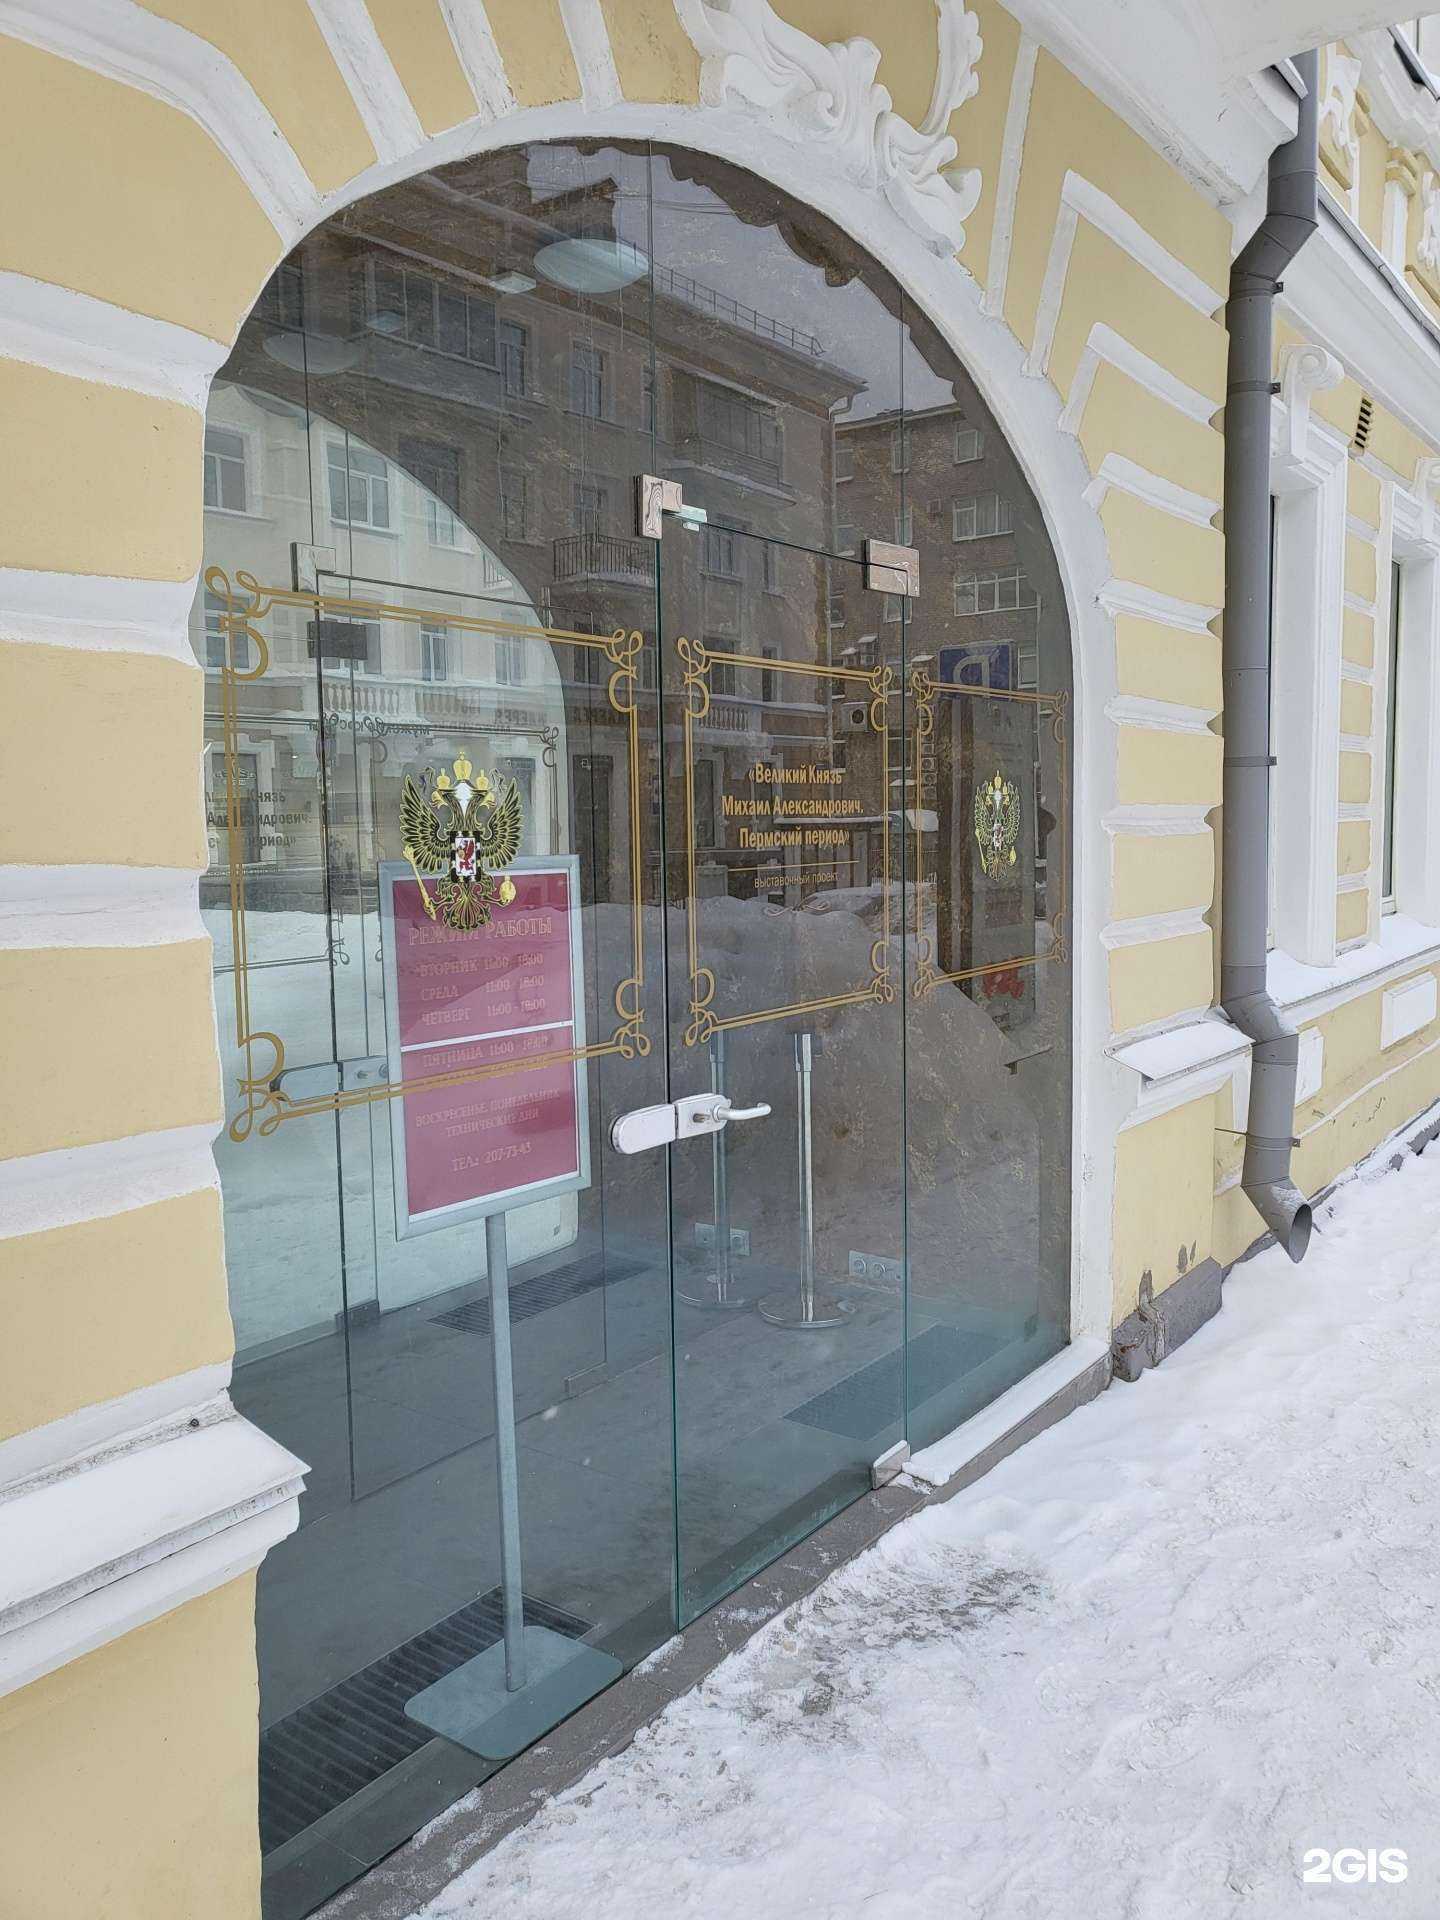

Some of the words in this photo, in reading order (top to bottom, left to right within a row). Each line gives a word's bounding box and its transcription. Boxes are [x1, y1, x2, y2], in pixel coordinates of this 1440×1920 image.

[749, 760, 807, 784] «Великий
[809, 765, 842, 784] Князь
[721, 795, 771, 815] Михаил
[773, 795, 864, 818] Александрович.
[739, 826, 802, 848] Пермский
[805, 829, 850, 848] период»
[486, 917, 552, 940] РАБОТЫ
[422, 986, 459, 1001] СРЕДА
[422, 1008, 472, 1025] ЧЕТВЕРГ
